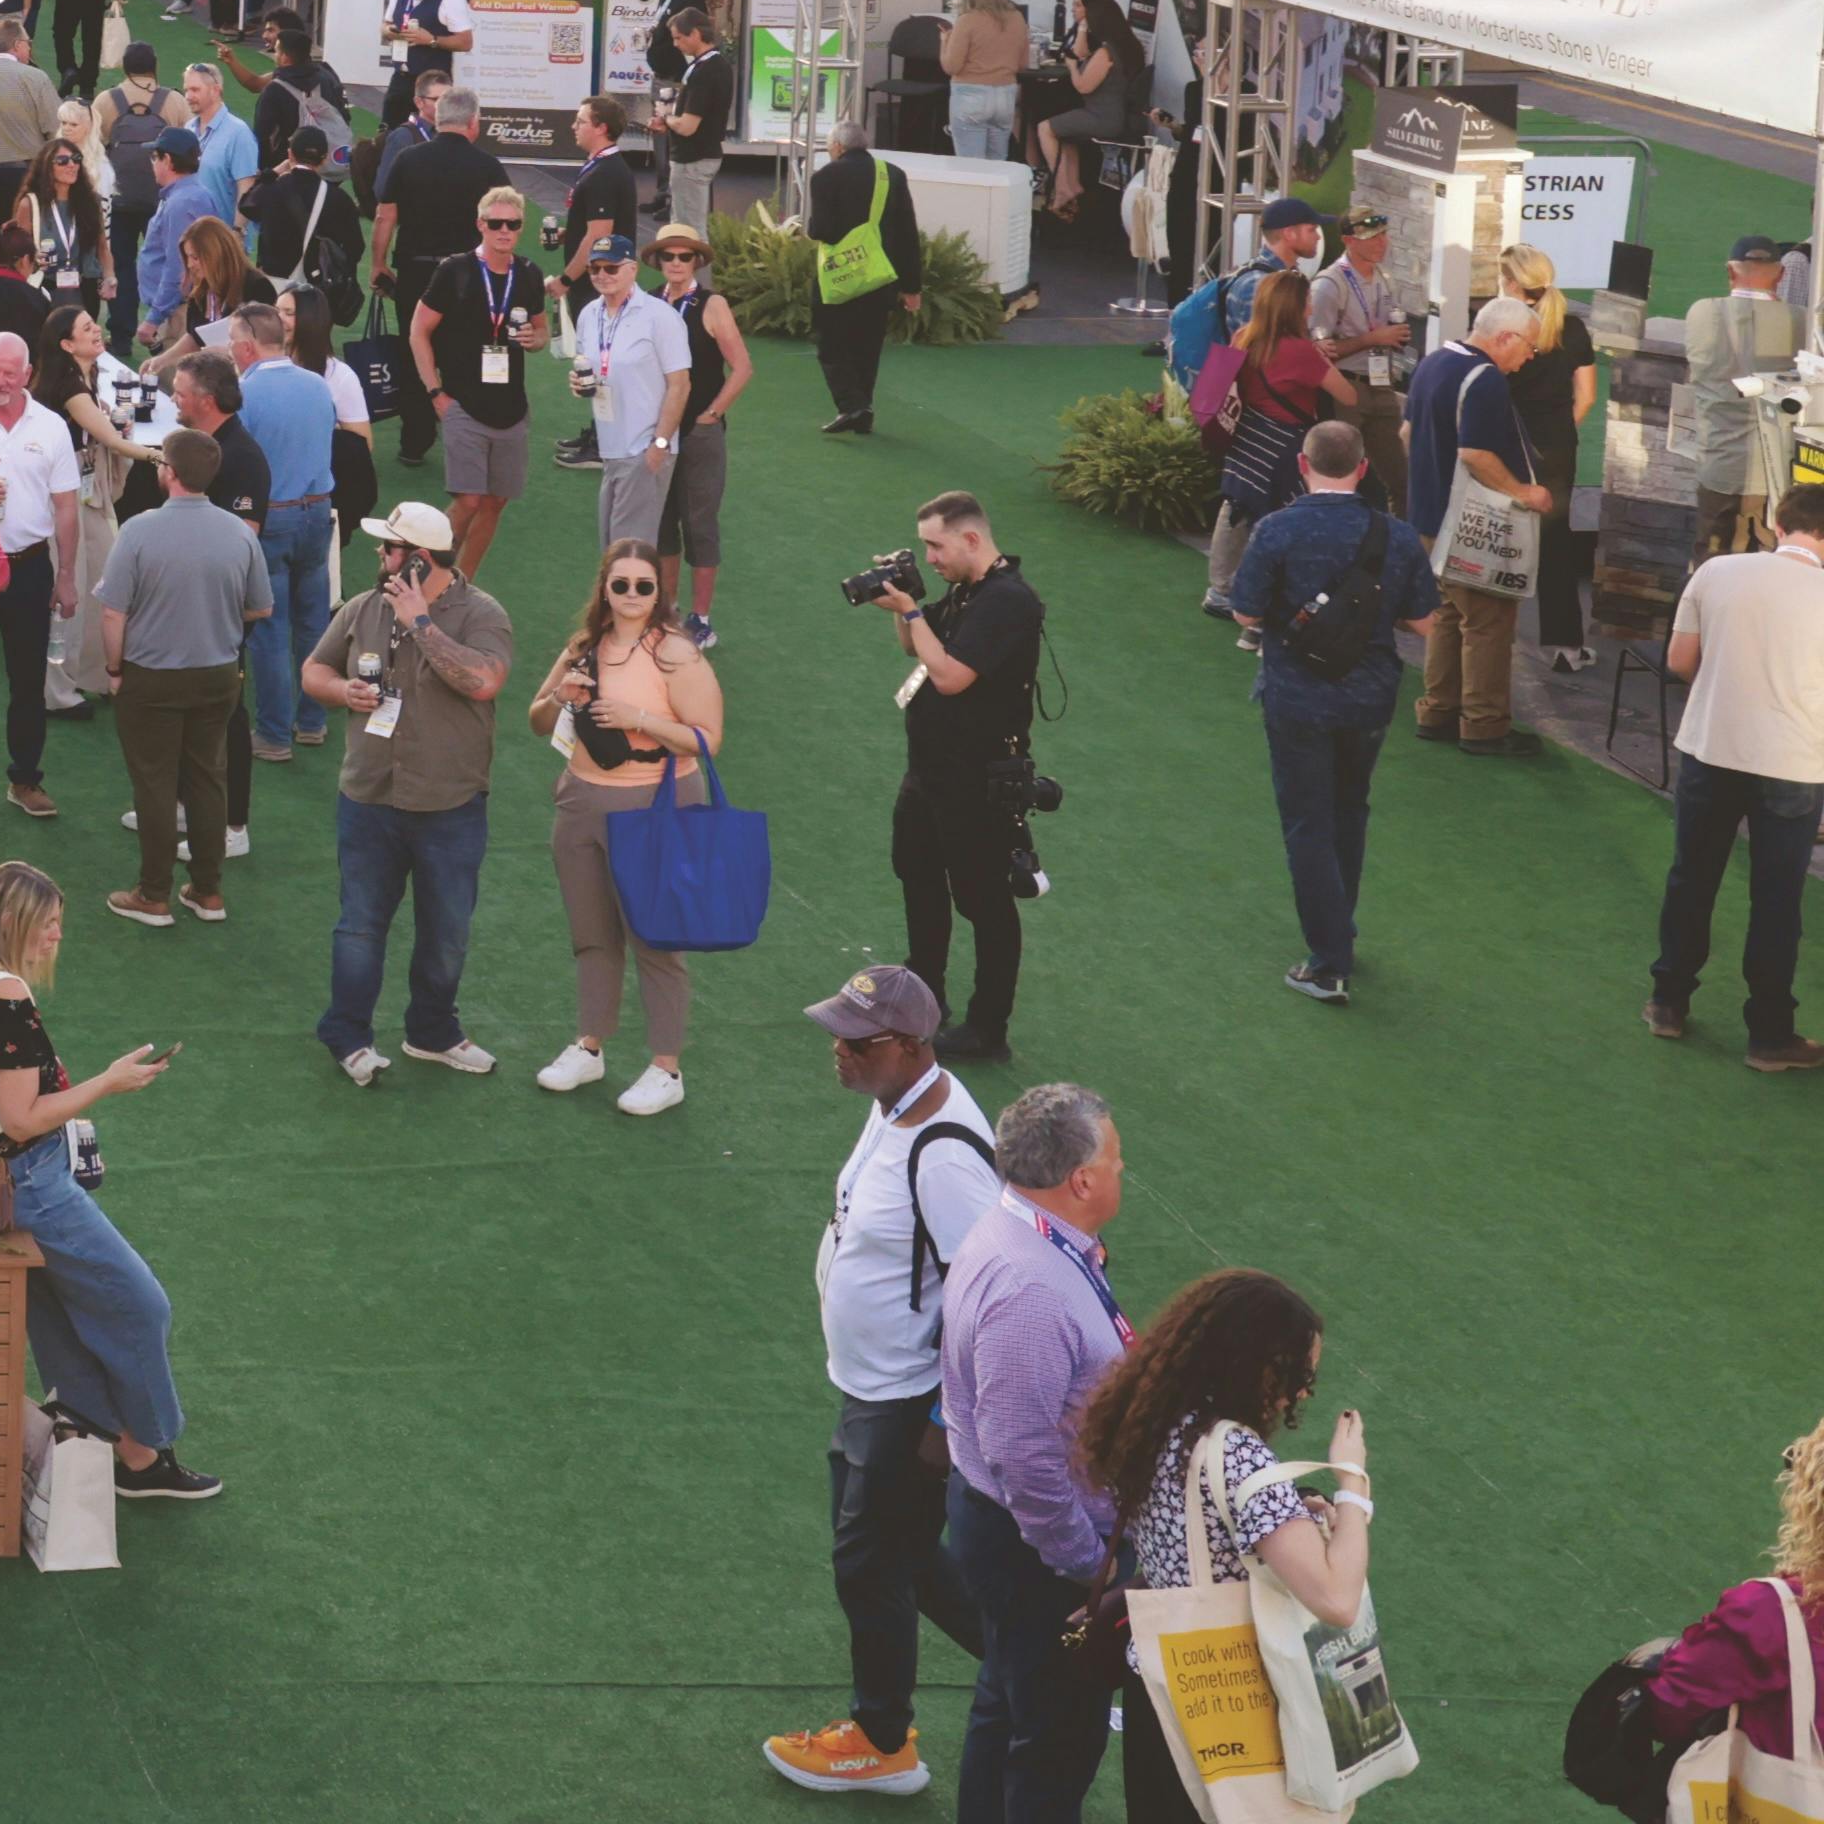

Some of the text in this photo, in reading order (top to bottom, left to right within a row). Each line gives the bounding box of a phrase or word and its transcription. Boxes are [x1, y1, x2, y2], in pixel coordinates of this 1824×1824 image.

[1448, 10, 1463, 29] of
[1467, 15, 1543, 50] Mortarless
[1547, 32, 1591, 62] Stone
[1597, 47, 1654, 77] Veneer
[487, 123, 555, 137] Bindus
[1524, 175, 1604, 192] STRIAN
[1521, 204, 1575, 220] CESS
[1461, 511, 1486, 527] WE
[1455, 534, 1485, 550] YOU
[1458, 523, 1502, 543] WHAT
[1494, 571, 1528, 589] IBS
[1171, 1640, 1252, 1667] I cook with
[1177, 1668, 1258, 1694] Sometimes
[1186, 1689, 1270, 1720] add it to the
